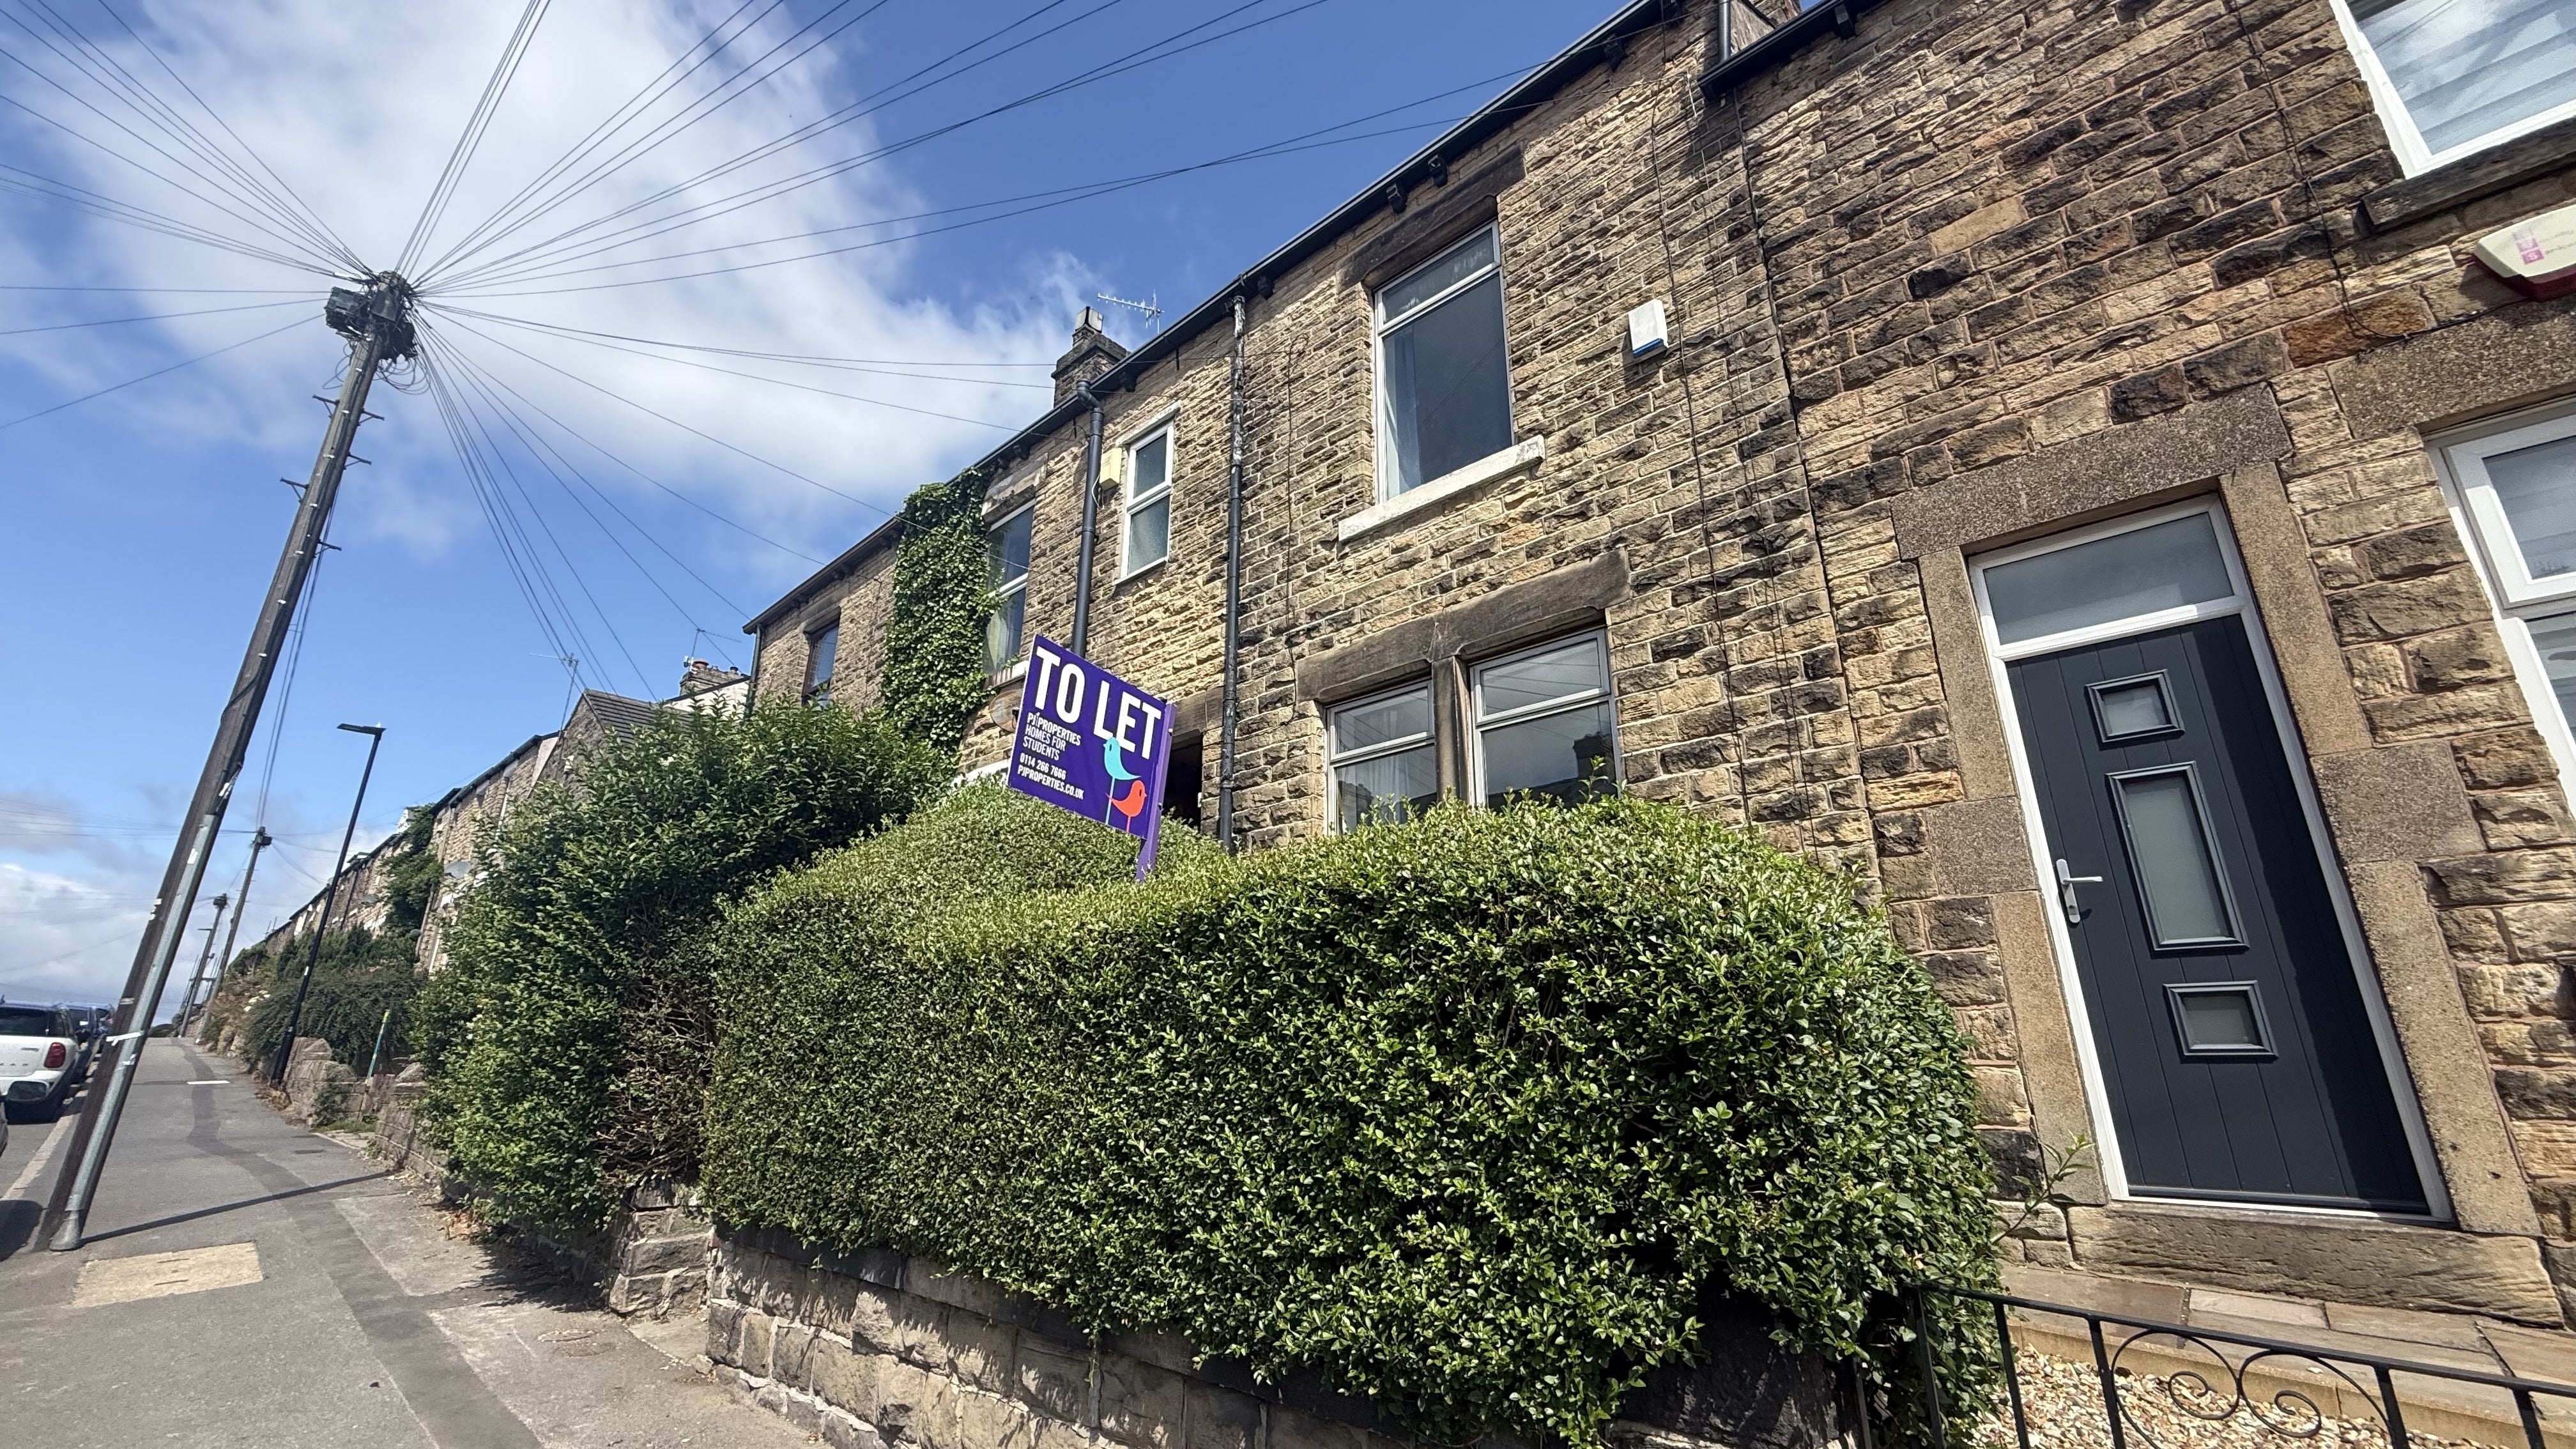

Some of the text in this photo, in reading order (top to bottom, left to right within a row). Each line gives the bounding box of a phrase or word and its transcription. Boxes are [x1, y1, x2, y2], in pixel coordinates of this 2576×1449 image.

[1035, 647, 1162, 760] TO LET
[1023, 736, 1060, 761] STUDENTS
[1025, 724, 1066, 751] HOMES FOR
[1020, 753, 1066, 780] 0114 266 7666
[1017, 765, 1084, 800] PJPROPERTIES.CO.UK
